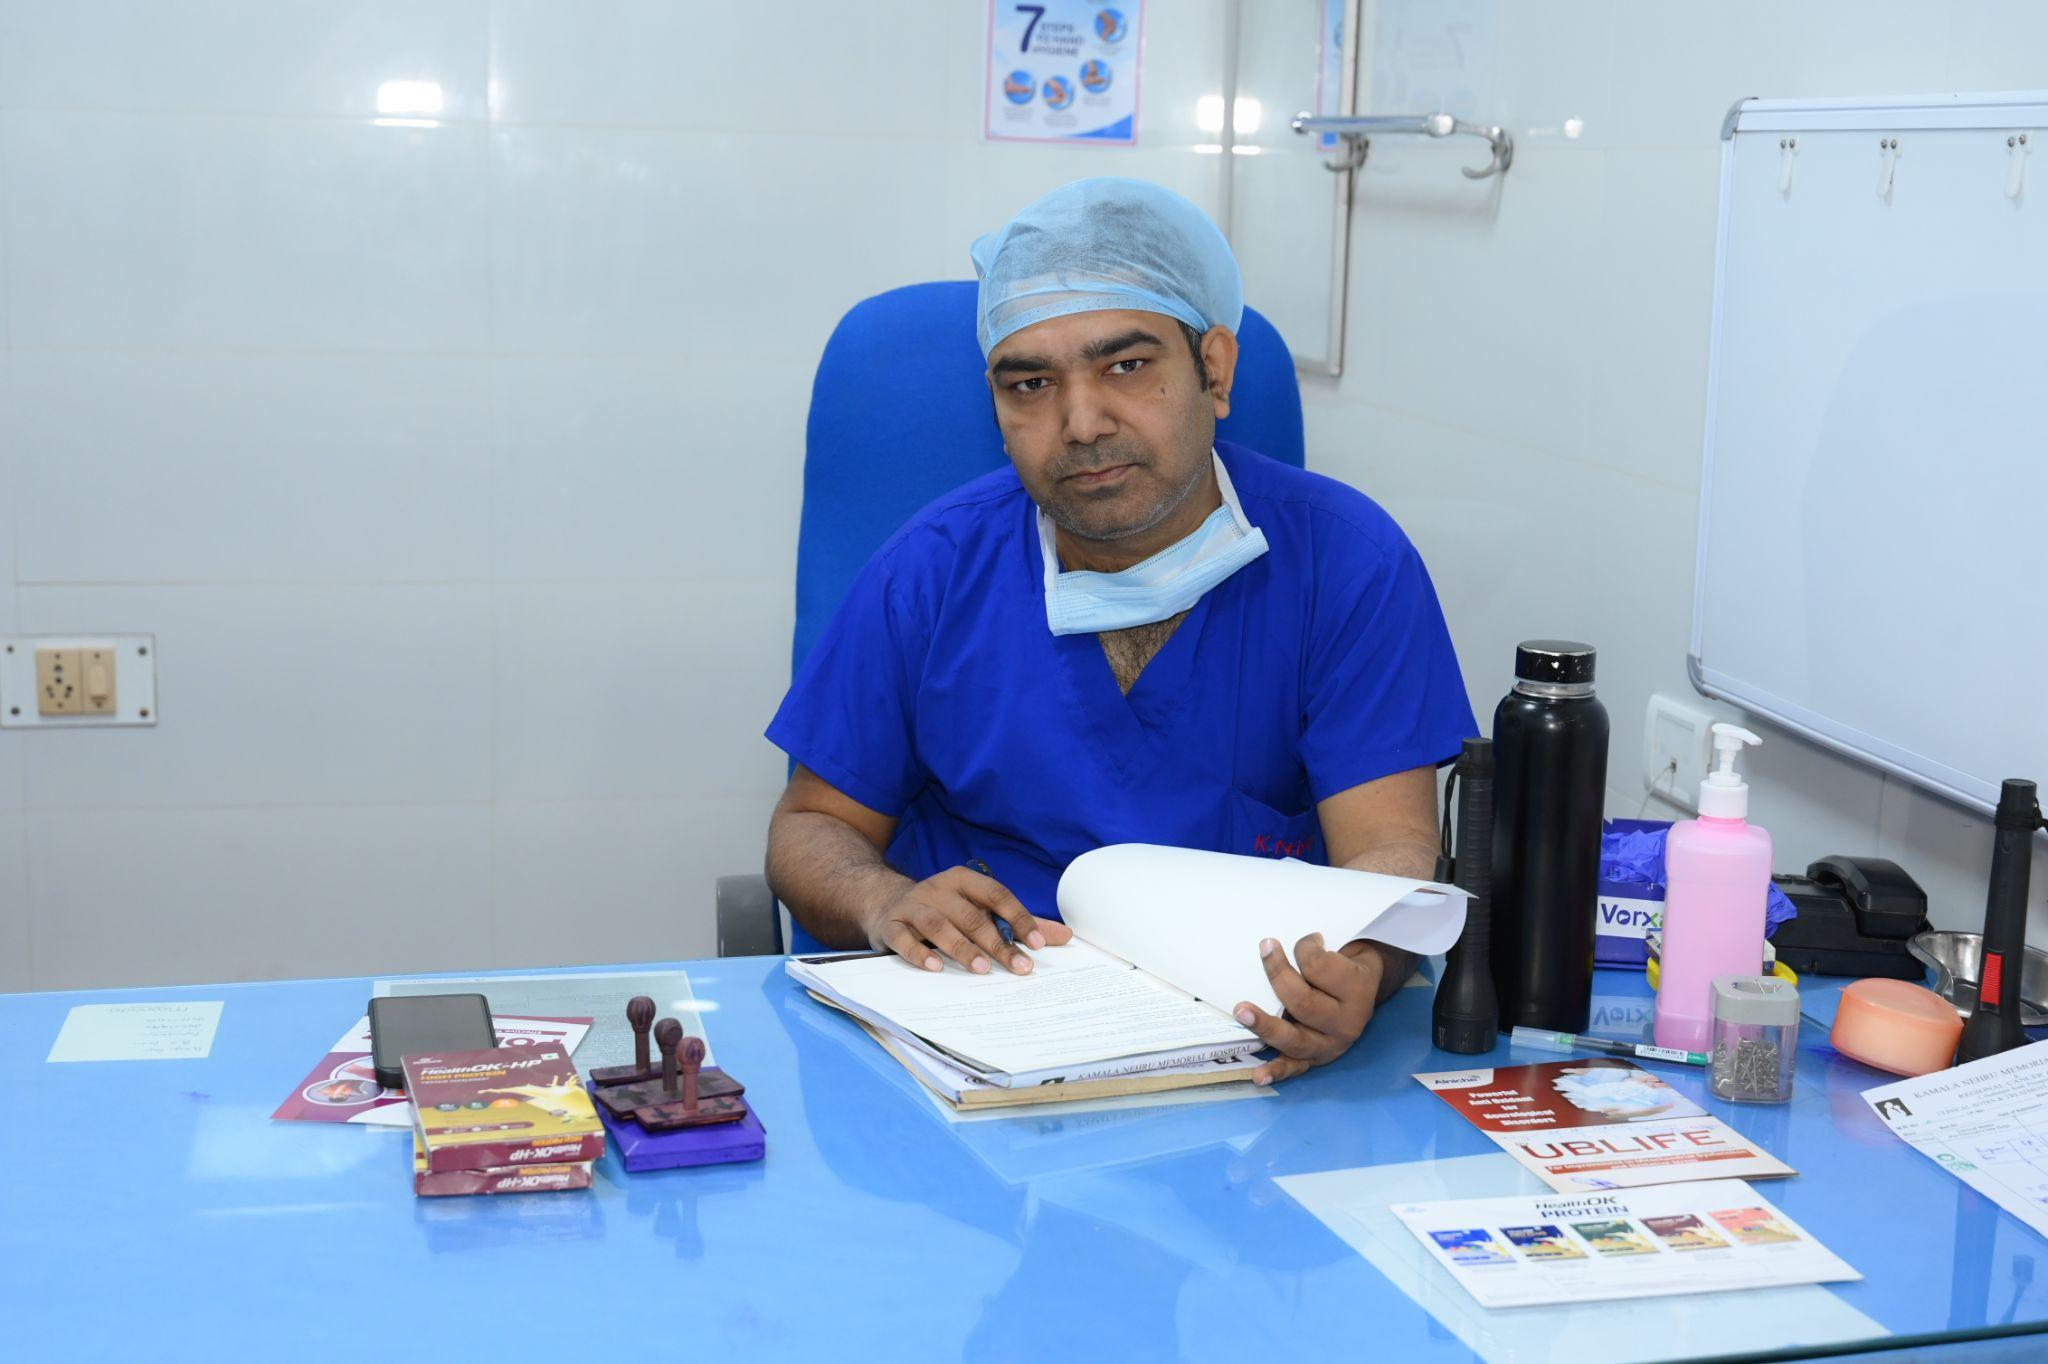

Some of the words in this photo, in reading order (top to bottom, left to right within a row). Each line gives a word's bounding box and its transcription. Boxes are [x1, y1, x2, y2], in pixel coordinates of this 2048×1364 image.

[1015, 4, 1046, 54] 7
[1031, 46, 1080, 57] HYGIENE
[421, 1059, 542, 1077] HealthOK-HP
[1077, 1068, 1120, 1080] KAMALA
[1121, 1061, 1155, 1074] NEHRU
[1155, 1053, 1206, 1067] MEMORIAL
[1209, 1045, 1252, 1060] HOSPITAL
[454, 1070, 506, 1079] PROTEIN
[1913, 1083, 1960, 1099] KAMALA
[1960, 1072, 1997, 1087] NEHRU
[1999, 1057, 2048, 1075] MEMORIA
[1469, 1089, 1518, 1098] Powerful
[1483, 1109, 1555, 1119] Neurological
[1500, 1117, 1556, 1126] Disorders
[509, 1143, 582, 1161] HealthOK-HP
[1521, 1129, 1726, 1159] UBLIFE
[1535, 1195, 1617, 1211] HealthOK
[1541, 1205, 1630, 1219] PROTEIN
